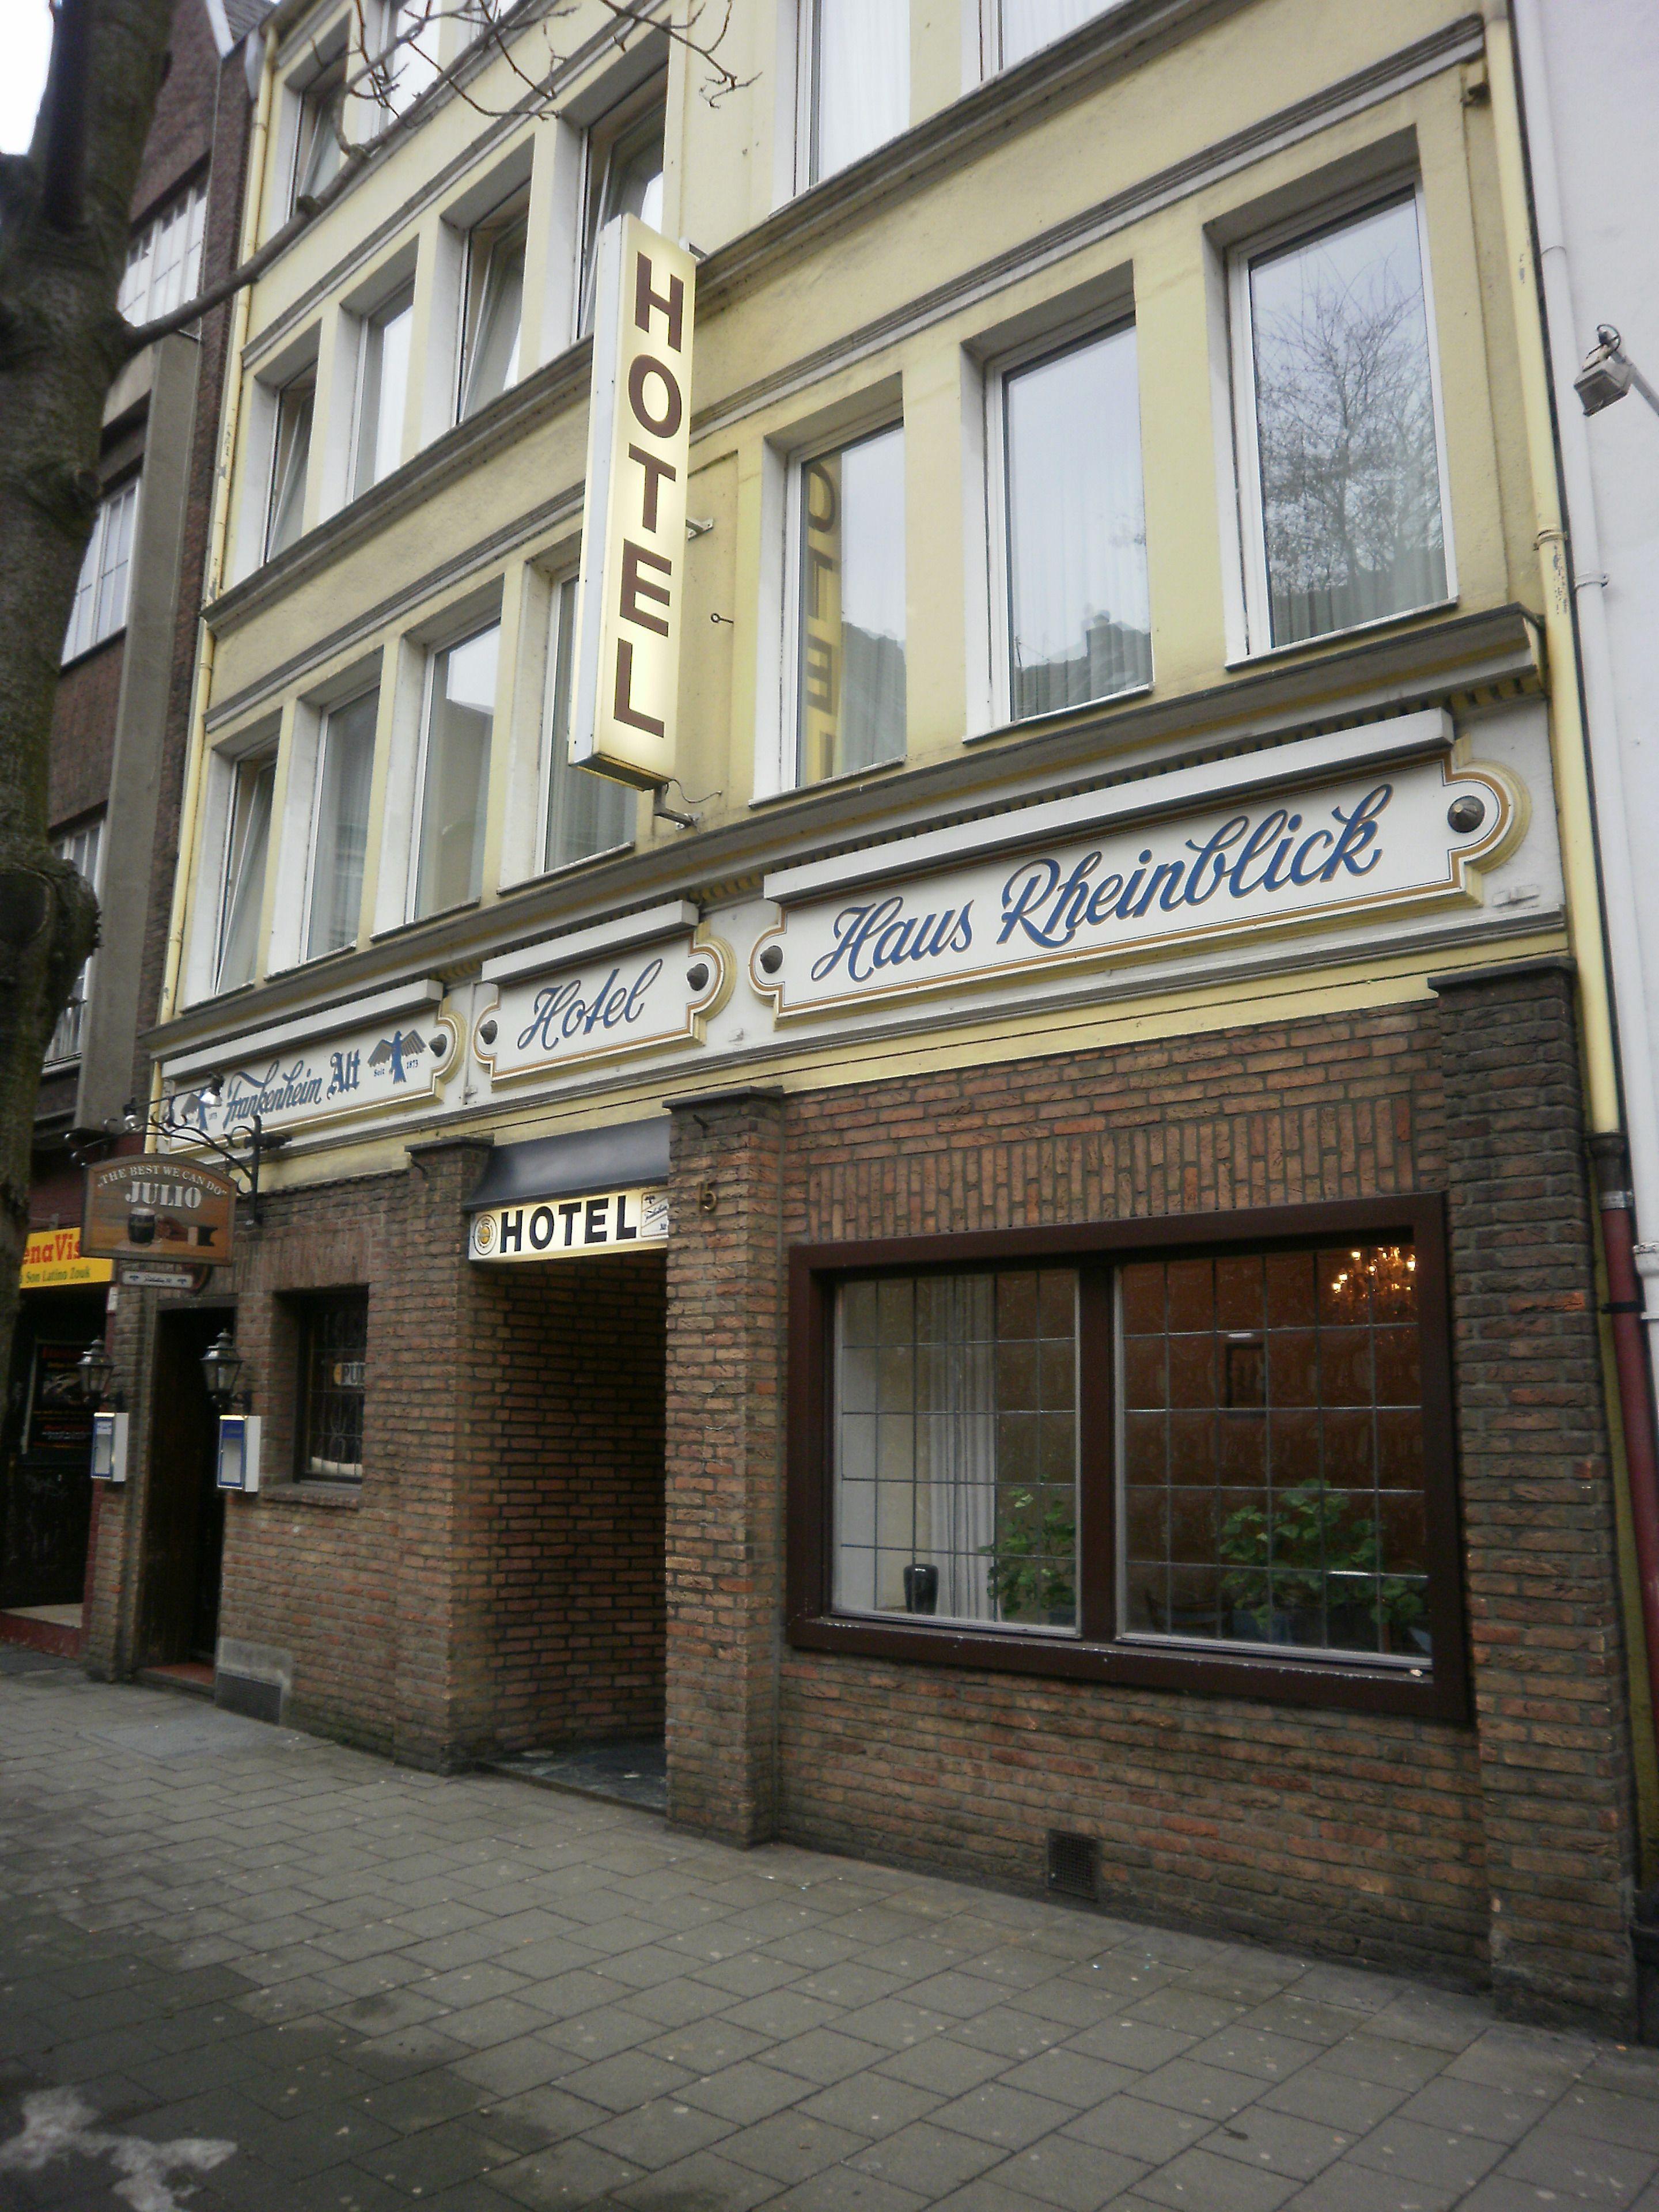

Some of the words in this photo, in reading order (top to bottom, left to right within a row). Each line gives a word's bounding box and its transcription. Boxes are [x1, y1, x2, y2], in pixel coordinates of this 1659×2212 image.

[614, 251, 684, 738] HOTEL
[811, 896, 974, 982] Haus
[998, 783, 1393, 949] Rheinblick
[517, 959, 663, 1051] Hotel
[223, 1060, 322, 1130] Frankenheim
[327, 1049, 360, 1100] Alt
[124, 1181, 202, 1208] JULIO
[130, 1165, 160, 1176] BEST
[163, 1165, 180, 1177] WE
[182, 1171, 205, 1185] CAN
[500, 1195, 637, 1254] HOTEL
